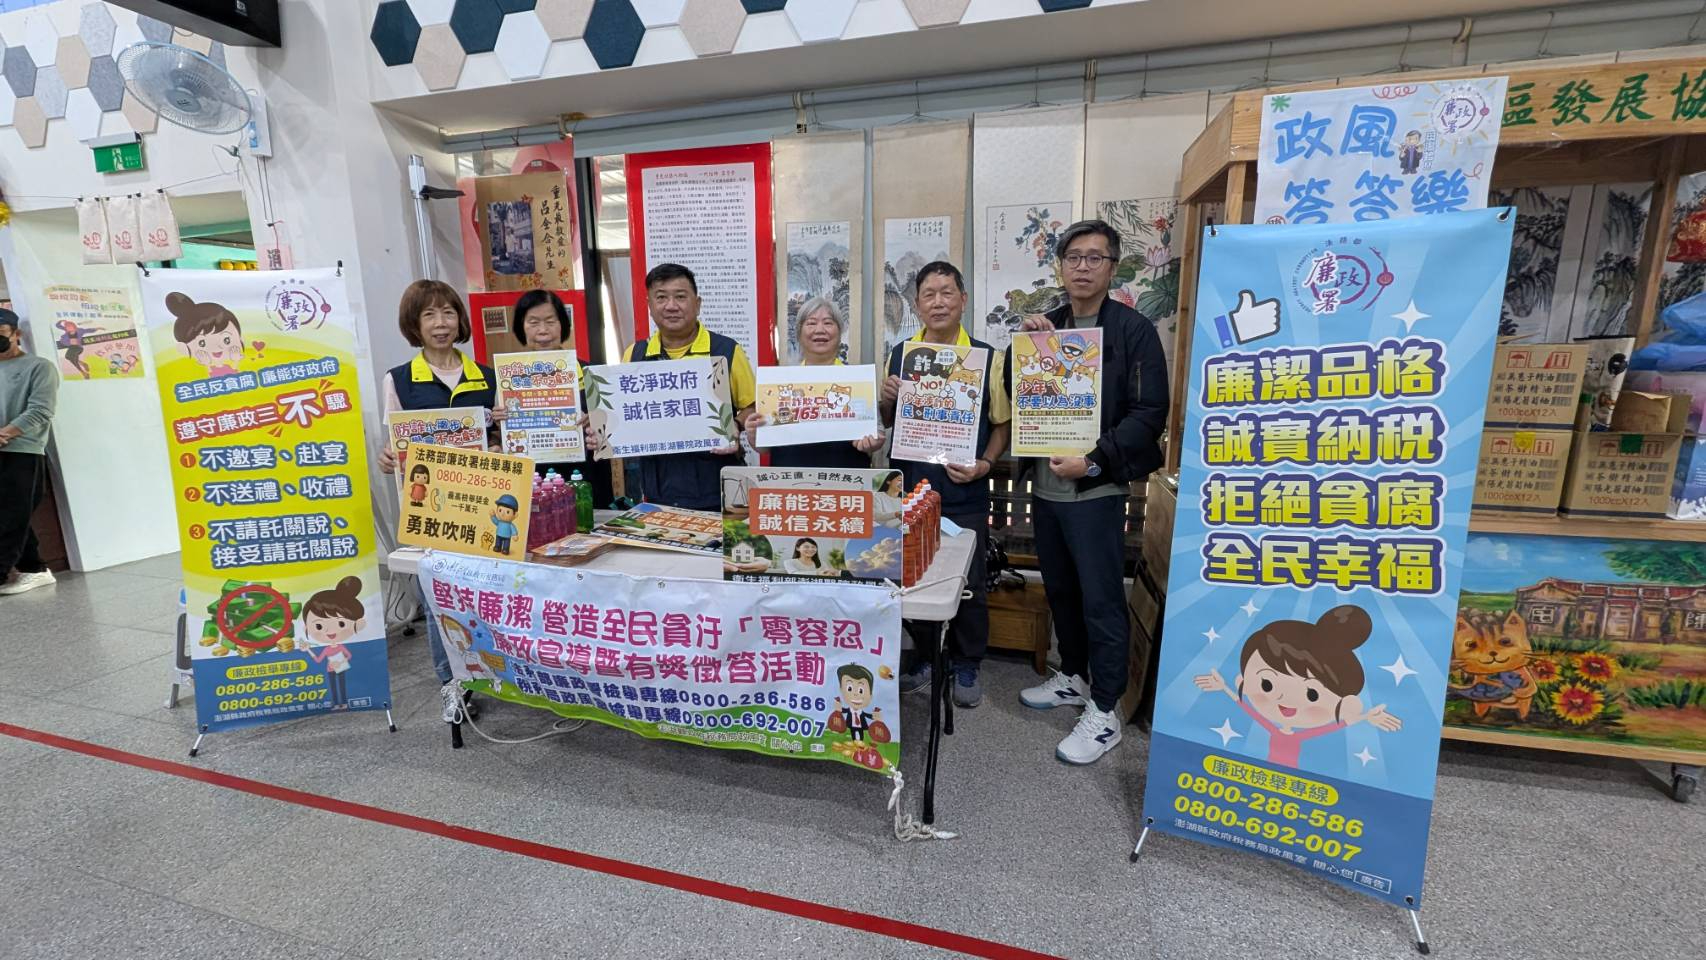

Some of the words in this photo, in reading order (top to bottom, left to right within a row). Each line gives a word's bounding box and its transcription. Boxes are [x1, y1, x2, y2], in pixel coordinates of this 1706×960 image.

[1274, 104, 1397, 164] 政風
[1283, 168, 1470, 224] 答答樂
[914, 354, 931, 371] 詐
[1207, 346, 1436, 403] 廉潔品格
[177, 374, 255, 400] 全民反貪腐
[262, 360, 336, 384] 廉能好政府
[619, 370, 698, 394] 乾淨政府
[920, 380, 943, 391] NO!
[623, 398, 701, 421] 誠信家園
[792, 407, 820, 420] 165
[902, 405, 975, 424] 民、刑事責任
[1017, 394, 1096, 408] 不要以為沒事
[612, 438, 721, 456] 衛生福利部澎湖醫院政風室
[1207, 413, 1435, 463] 誠實納稅
[202, 442, 346, 469] 不邀宴、赴宴
[416, 447, 523, 475] 法務部廉政署檢舉專線
[206, 476, 350, 504] 不送禮、收禮
[436, 468, 512, 490] 0800-286-586
[758, 493, 865, 513] 廉能透明
[1207, 480, 1435, 527] 拒絕貪腐
[406, 514, 477, 545] 勇敢吹哨
[758, 514, 865, 534] 誠信永續
[213, 539, 355, 567] 接受請託關說
[1207, 538, 1433, 591] 全民幸福
[432, 577, 533, 630] 堅持廉潔
[232, 662, 303, 678] 廉政檢舉專線
[491, 628, 825, 685] 廉政宣導暨有獎徵答活動
[215, 674, 324, 696] 0800-286-586
[219, 689, 328, 711] 0800-692-007
[1211, 759, 1329, 804] 廉政檢舉專線
[1177, 772, 1365, 837] 0800-286-586
[1174, 796, 1362, 862] 0800-692-007
[1174, 817, 1308, 865] 澎湖縣政府稅務局政風室
[1312, 859, 1353, 878] 關心您
[1360, 875, 1385, 890] 廣告
